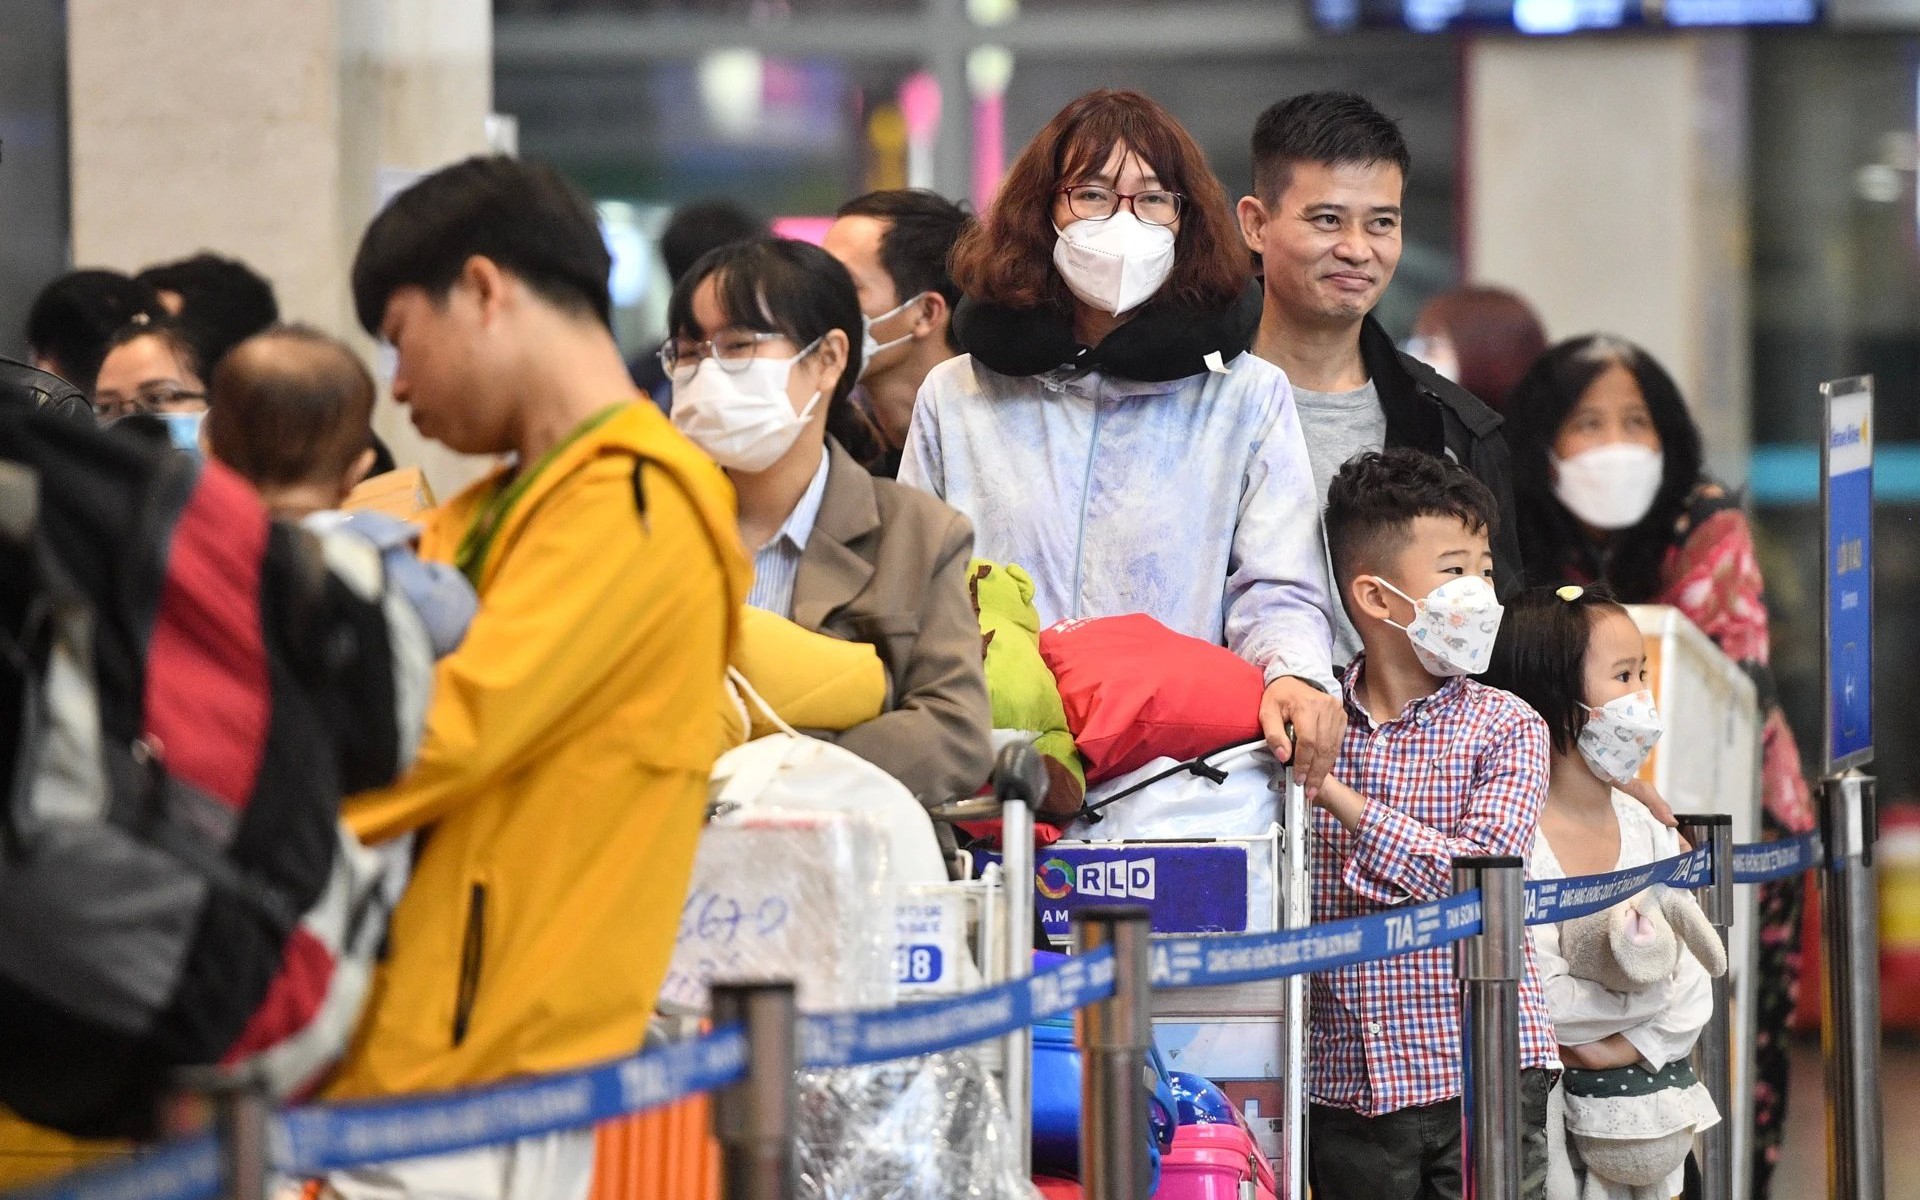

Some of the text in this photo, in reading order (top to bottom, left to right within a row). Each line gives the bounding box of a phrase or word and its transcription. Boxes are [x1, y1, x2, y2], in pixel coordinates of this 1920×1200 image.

[1035, 858, 1153, 899] ORLD
[1042, 909, 1069, 923] AM
[1524, 888, 1536, 919] IA
[1384, 914, 1413, 951] TIA
